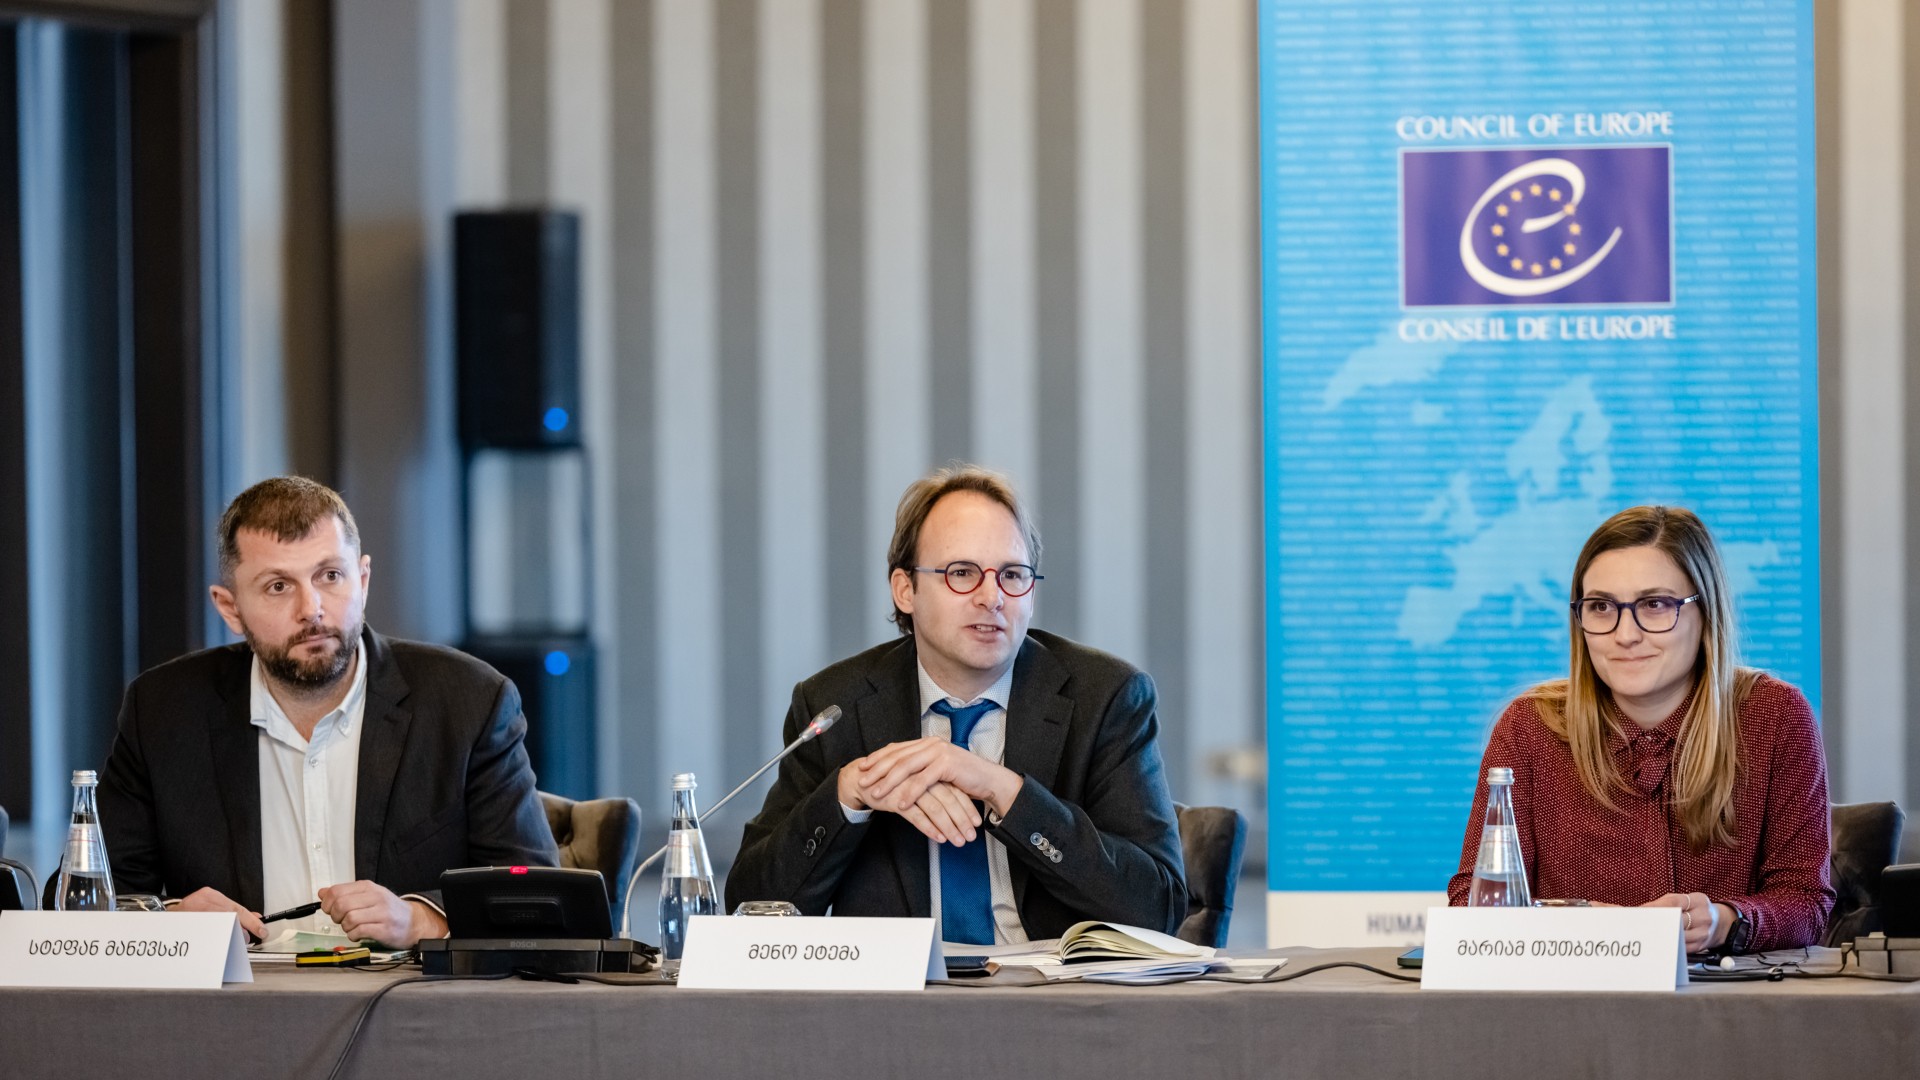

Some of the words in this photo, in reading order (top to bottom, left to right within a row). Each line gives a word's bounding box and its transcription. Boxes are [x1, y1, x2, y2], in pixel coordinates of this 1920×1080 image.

[1396, 115, 1520, 141] COUNCIL
[1527, 113, 1565, 138] OF
[1574, 111, 1673, 137] EUROPE
[1399, 318, 1511, 343] CONSEIL
[1516, 317, 1551, 341] DE
[1559, 315, 1675, 340] L'EUROPE
[1367, 913, 1427, 934] HUMA
[28, 939, 100, 956] სტეფან
[105, 940, 189, 957] მანევსკი
[748, 943, 798, 960] მენო
[803, 944, 860, 961] ეტემა
[1457, 939, 1525, 956] მარიამ
[1531, 940, 1642, 957] თუთბერიძე
